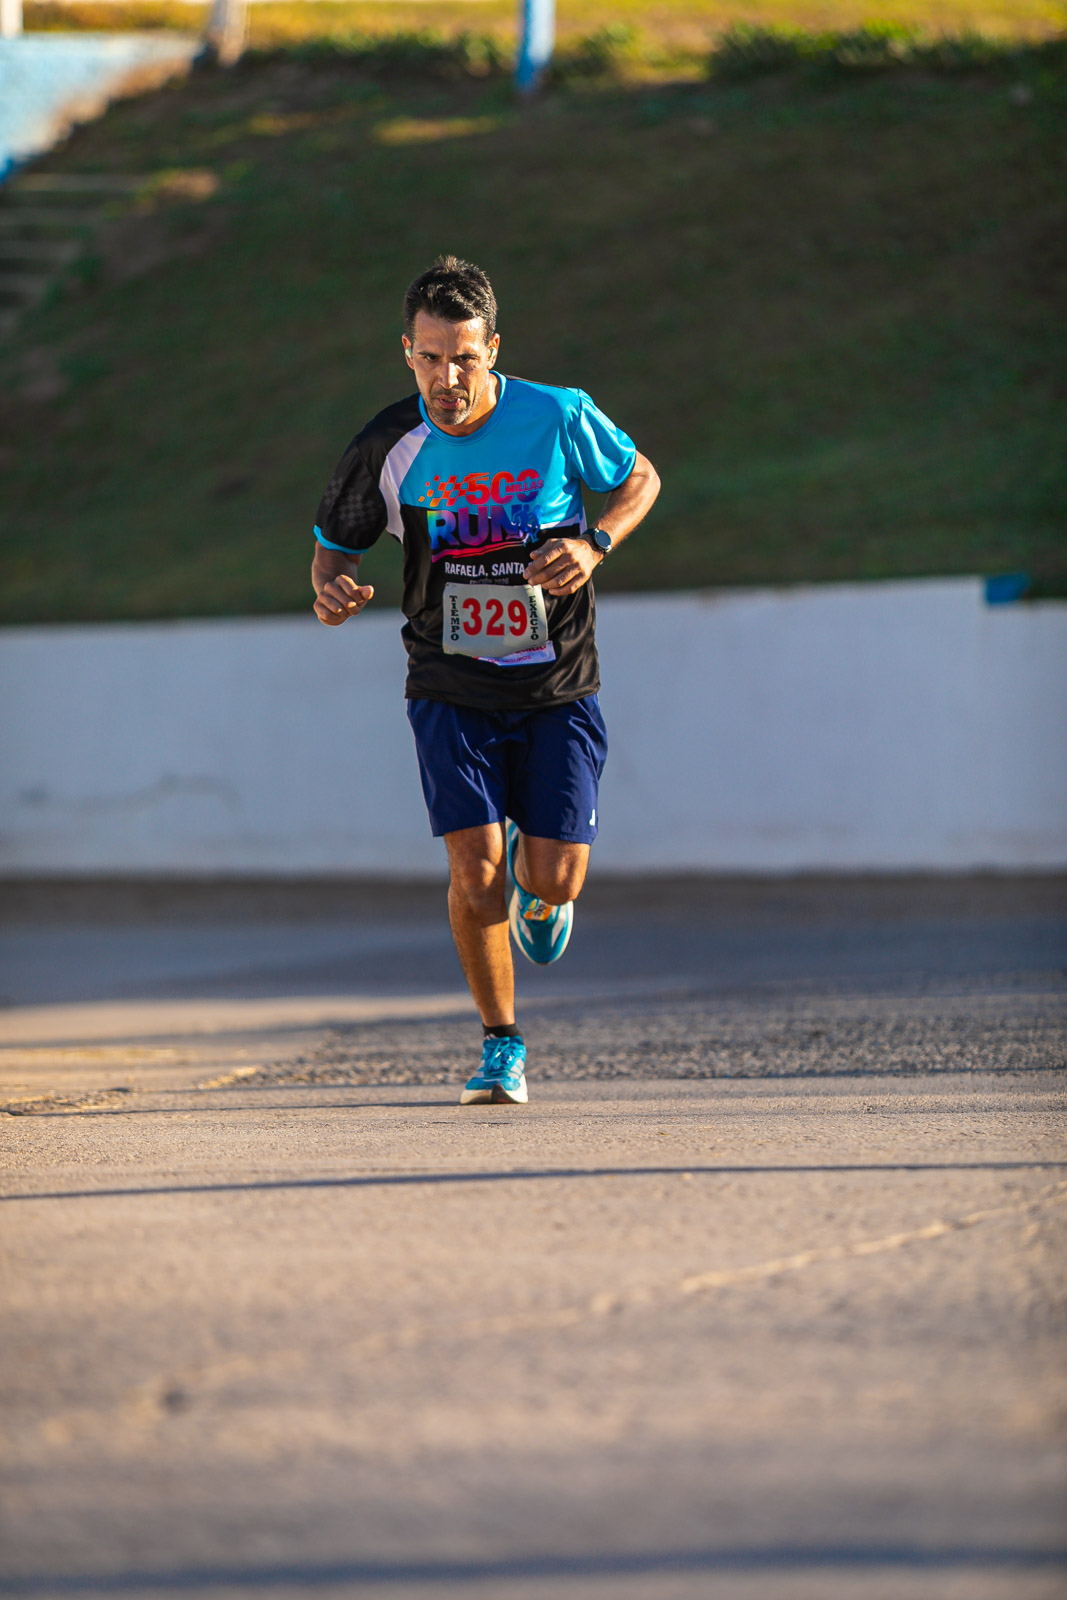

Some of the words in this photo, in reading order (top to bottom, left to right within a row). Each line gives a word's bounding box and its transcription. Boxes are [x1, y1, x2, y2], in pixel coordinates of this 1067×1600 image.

[464, 469, 540, 505] 500
[505, 479, 544, 494] MILLAS
[427, 504, 521, 549] RUN
[444, 562, 489, 577] RAFAELA,
[491, 562, 525, 576] SANTA
[449, 595, 460, 641] TIEMPO
[462, 598, 528, 637] 329
[528, 595, 539, 641] EXACTO
